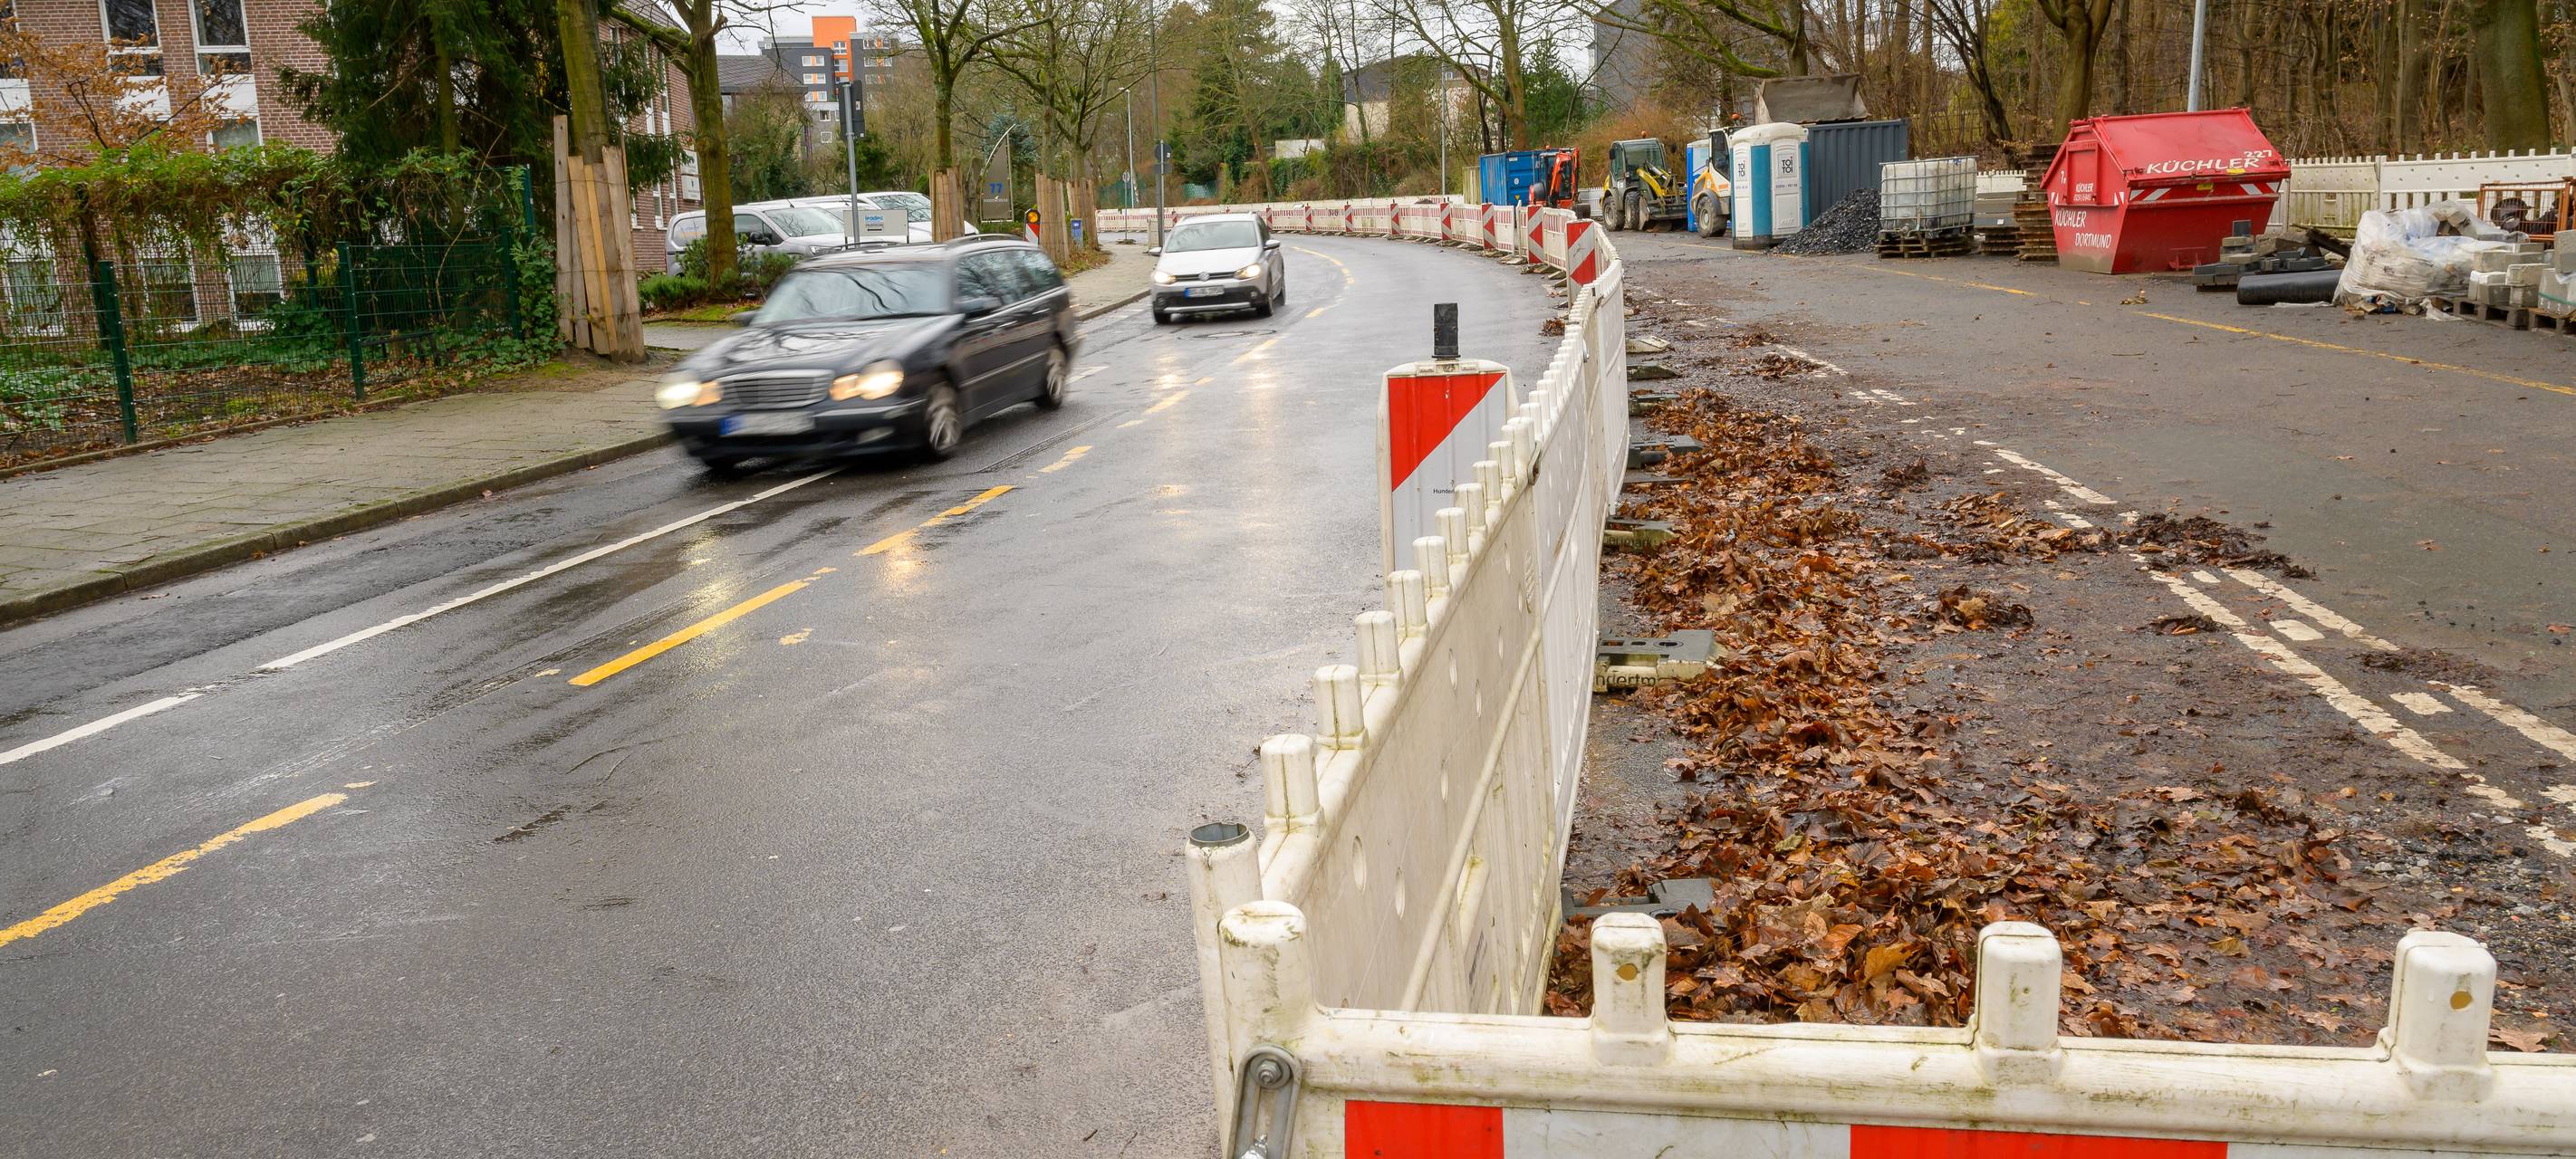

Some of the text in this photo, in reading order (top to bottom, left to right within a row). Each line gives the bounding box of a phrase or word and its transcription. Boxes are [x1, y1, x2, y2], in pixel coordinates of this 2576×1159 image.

[2244, 149, 2273, 158] 227
[2147, 158, 2260, 174] KÜCHLER
[989, 183, 1003, 195] 77
[2054, 209, 2087, 228] KÜCHLER
[2075, 232, 2112, 248] DORTMUND
[1595, 673, 1656, 686] ndertm
